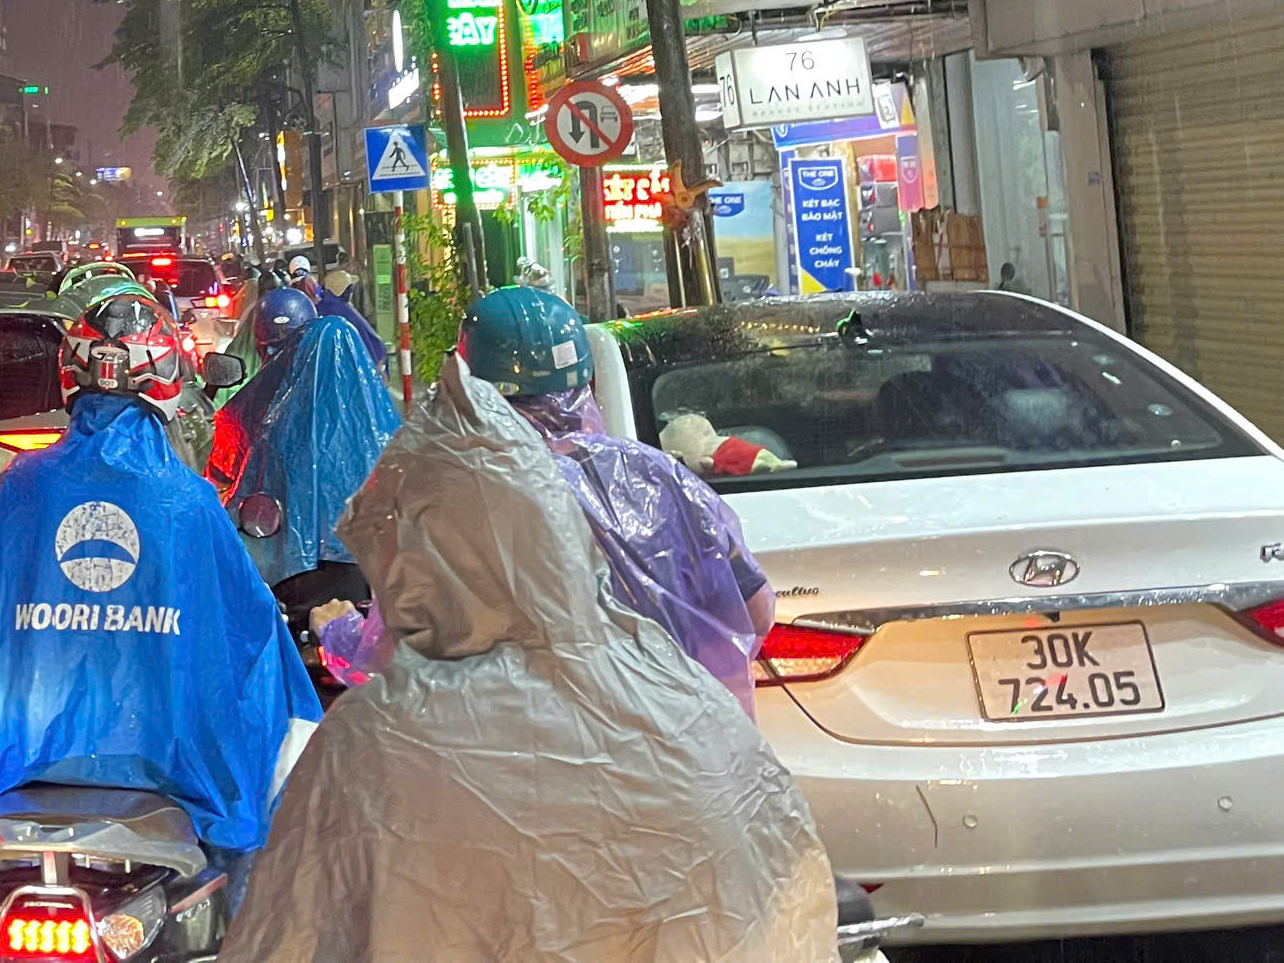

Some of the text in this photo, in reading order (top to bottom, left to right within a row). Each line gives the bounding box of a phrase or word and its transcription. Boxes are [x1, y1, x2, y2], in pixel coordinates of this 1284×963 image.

[785, 50, 815, 72] 76
[719, 74, 735, 107] 76
[749, 78, 861, 104] LAN ANH
[15, 602, 181, 636] WOORI BANK
[1021, 631, 1100, 670] 30K
[998, 670, 1142, 714] 724.05
